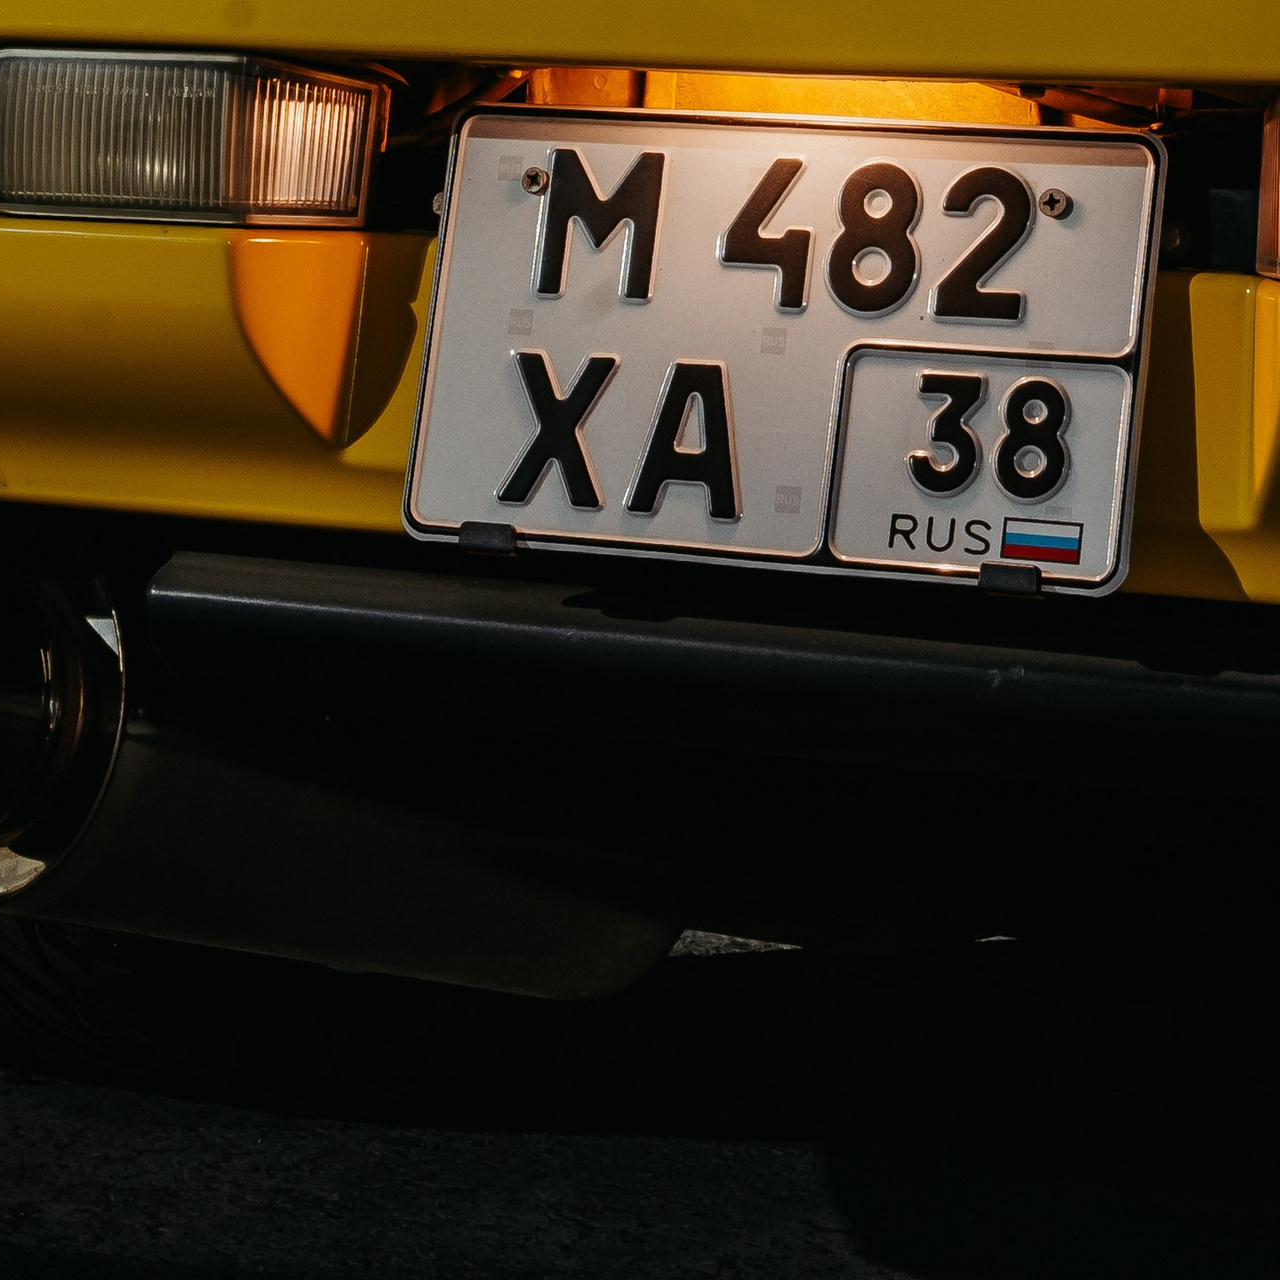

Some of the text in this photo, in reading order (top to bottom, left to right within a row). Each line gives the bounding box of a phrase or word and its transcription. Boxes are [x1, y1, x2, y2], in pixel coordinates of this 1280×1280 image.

[535, 148, 1032, 320] M 482
[497, 352, 741, 520] XA
[908, 374, 1070, 498] 38
[888, 514, 991, 555] RUS
